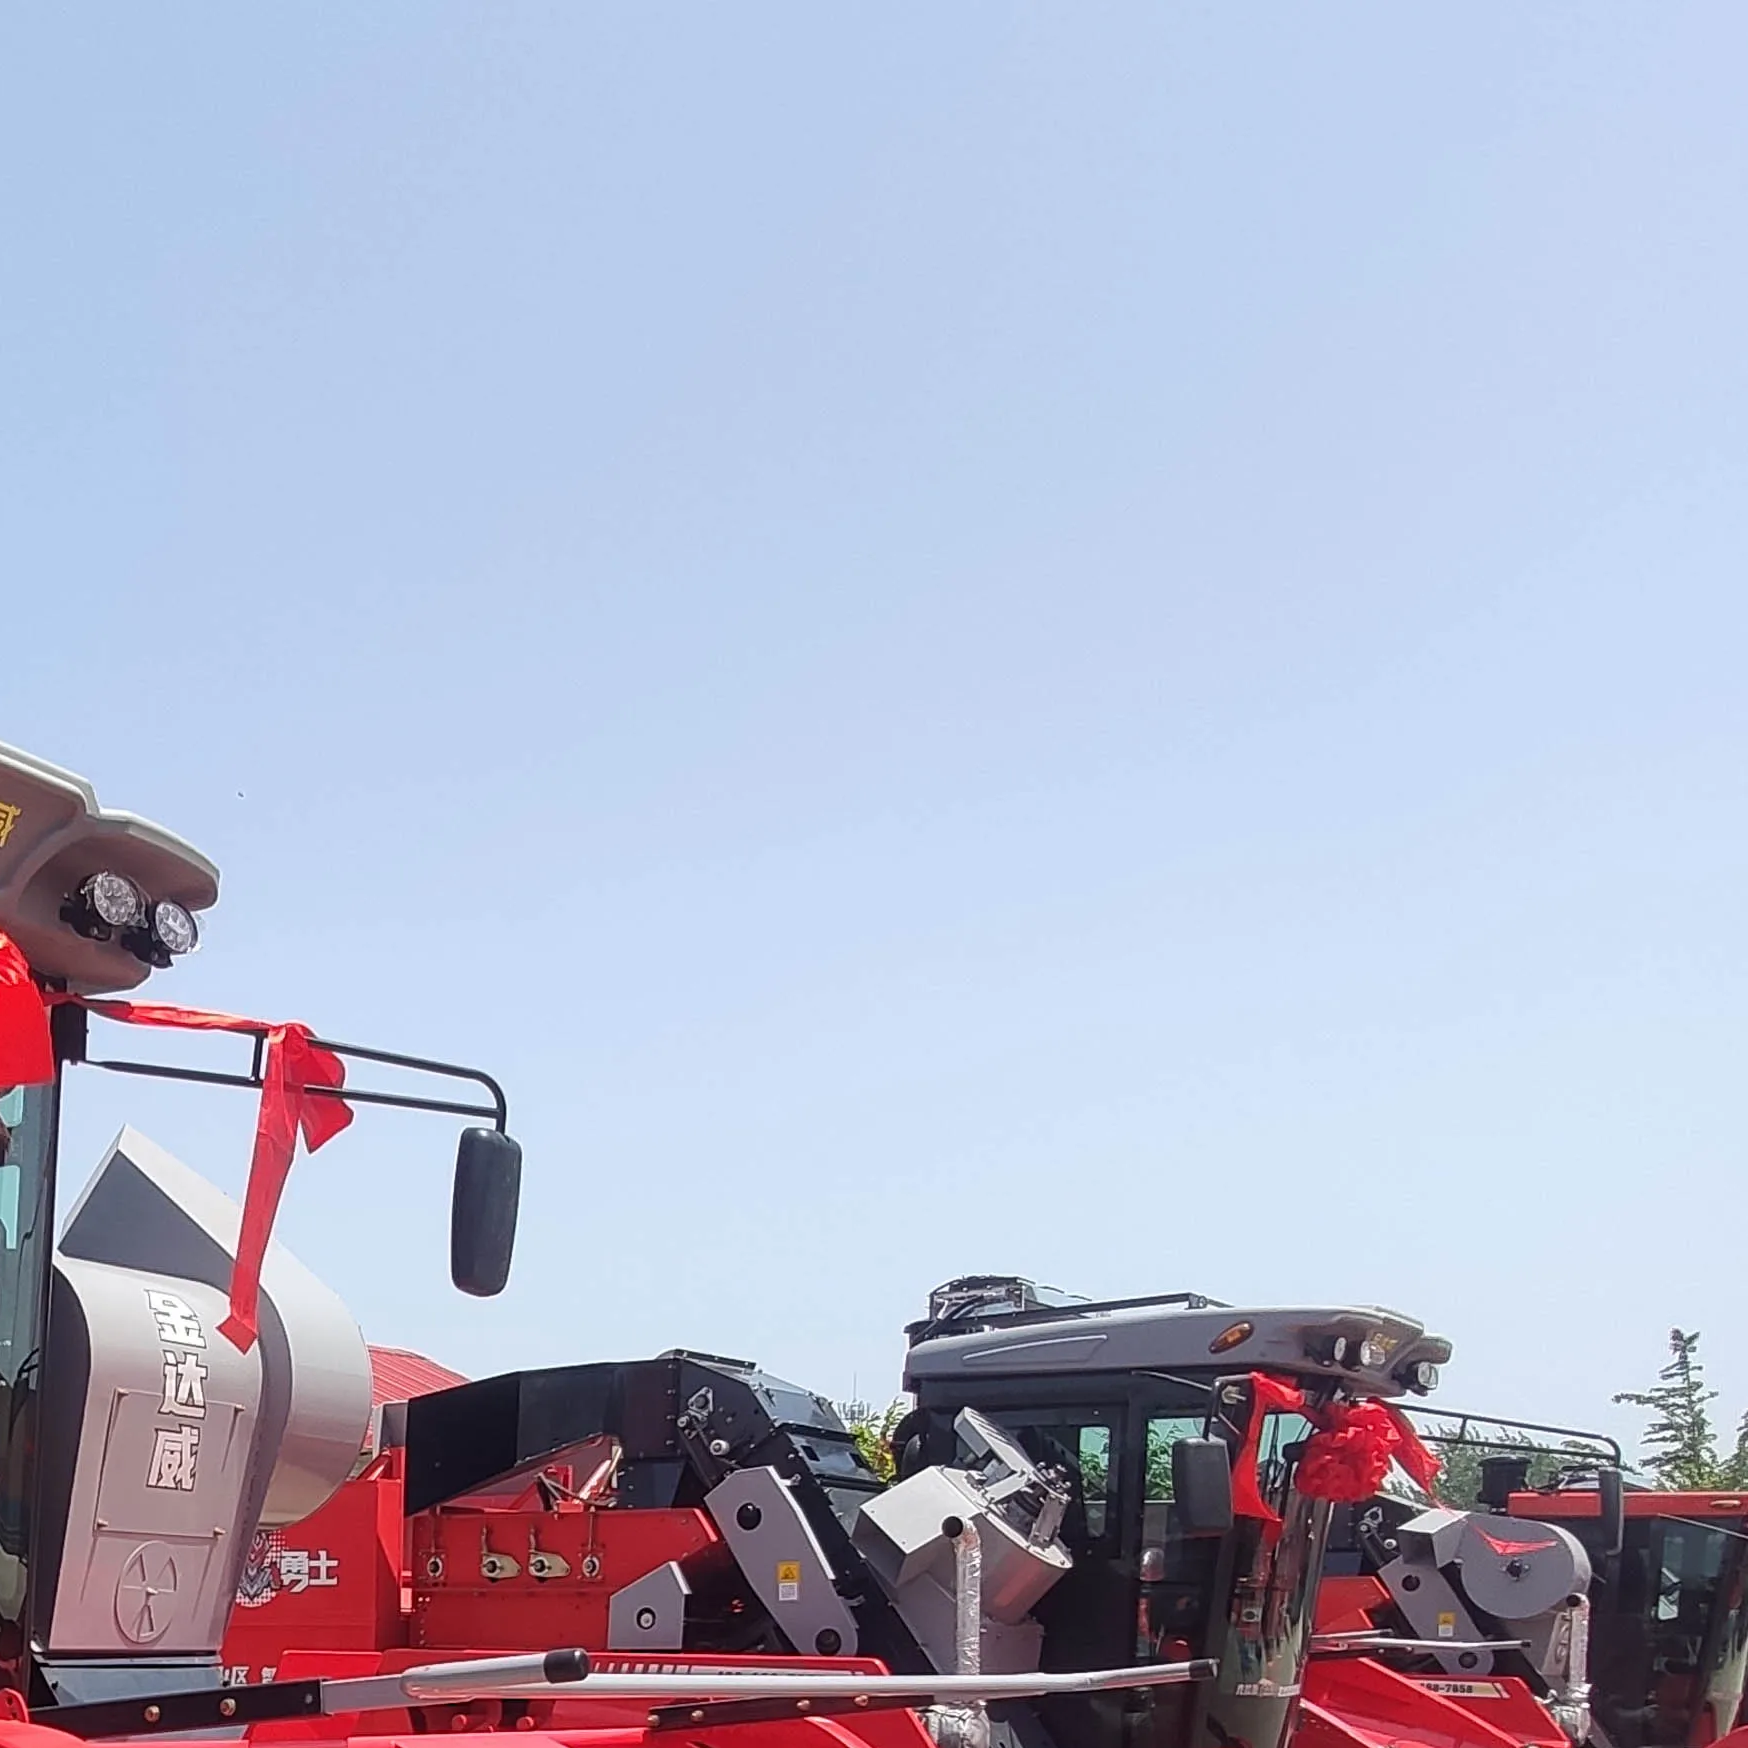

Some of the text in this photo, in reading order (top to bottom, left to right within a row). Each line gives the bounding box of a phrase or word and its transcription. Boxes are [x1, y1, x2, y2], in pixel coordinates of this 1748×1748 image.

[144, 1288, 209, 1492] 金达威
[280, 1549, 340, 1593] 勇士
